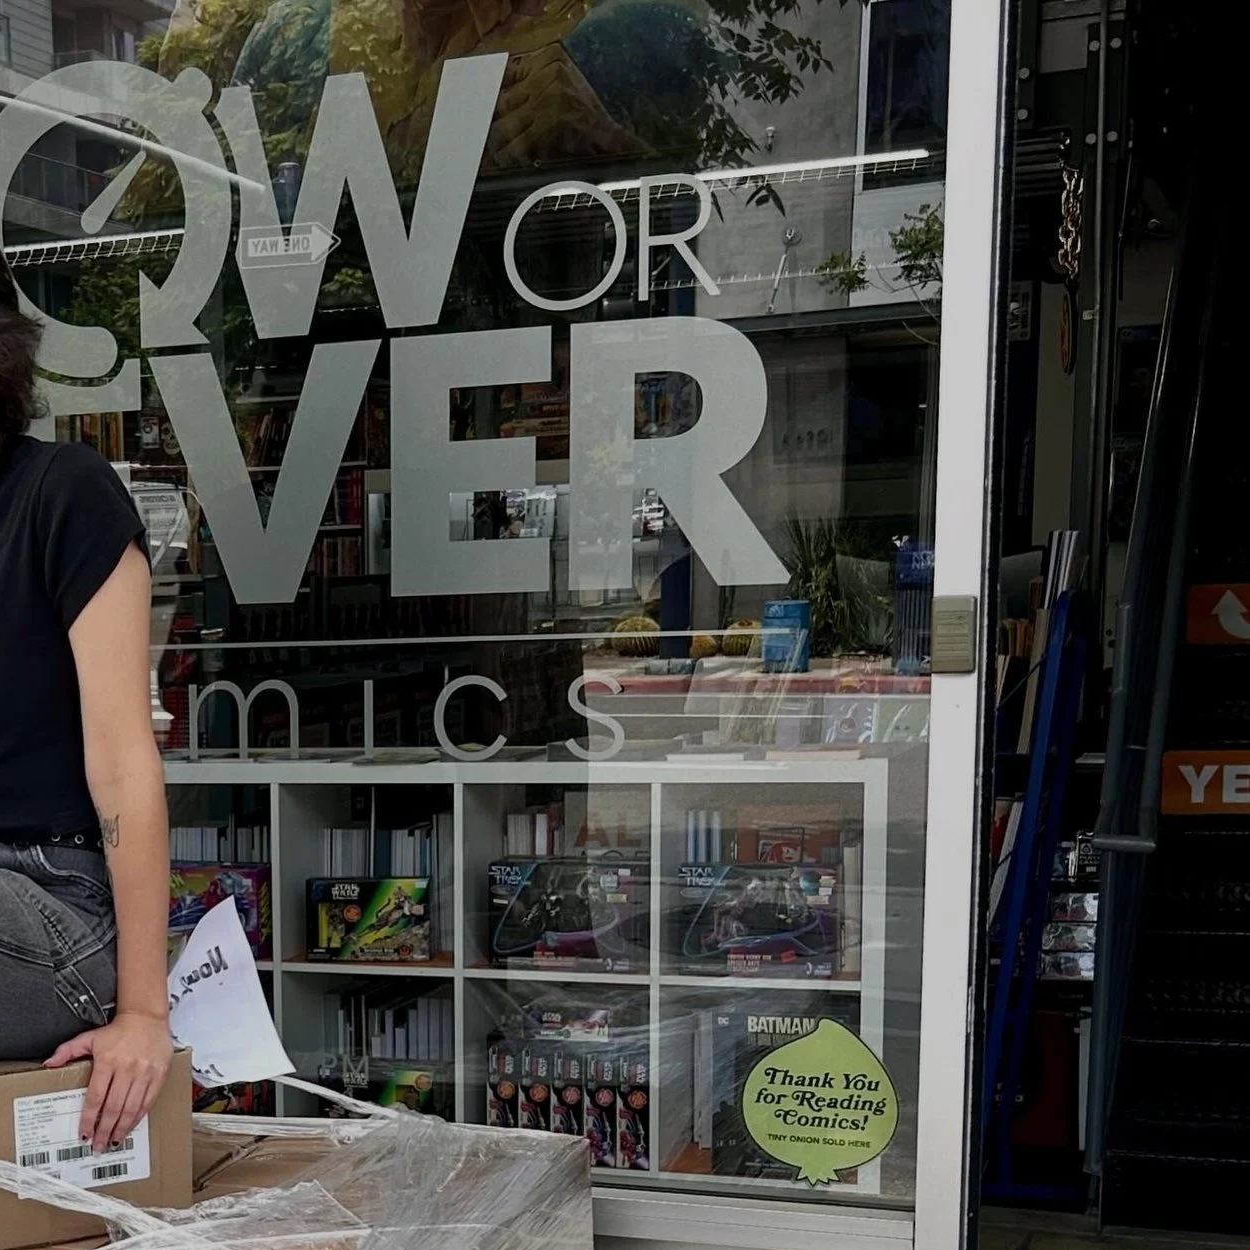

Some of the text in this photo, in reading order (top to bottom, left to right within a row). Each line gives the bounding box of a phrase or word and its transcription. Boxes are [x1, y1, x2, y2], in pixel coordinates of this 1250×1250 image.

[503, 173, 721, 311] OR
[488, 866, 520, 875] STAR
[678, 868, 713, 877] STAR
[495, 875, 522, 885] TREK
[686, 877, 717, 887] TREK
[718, 1017, 729, 1026] DC
[747, 1015, 815, 1034] BATMAN
[764, 1067, 880, 1092] Thank You
[754, 1088, 887, 1116] for Reading
[774, 1109, 869, 1131] Comics!
[768, 1133, 871, 1149] TINY ONION SOLD HERE
